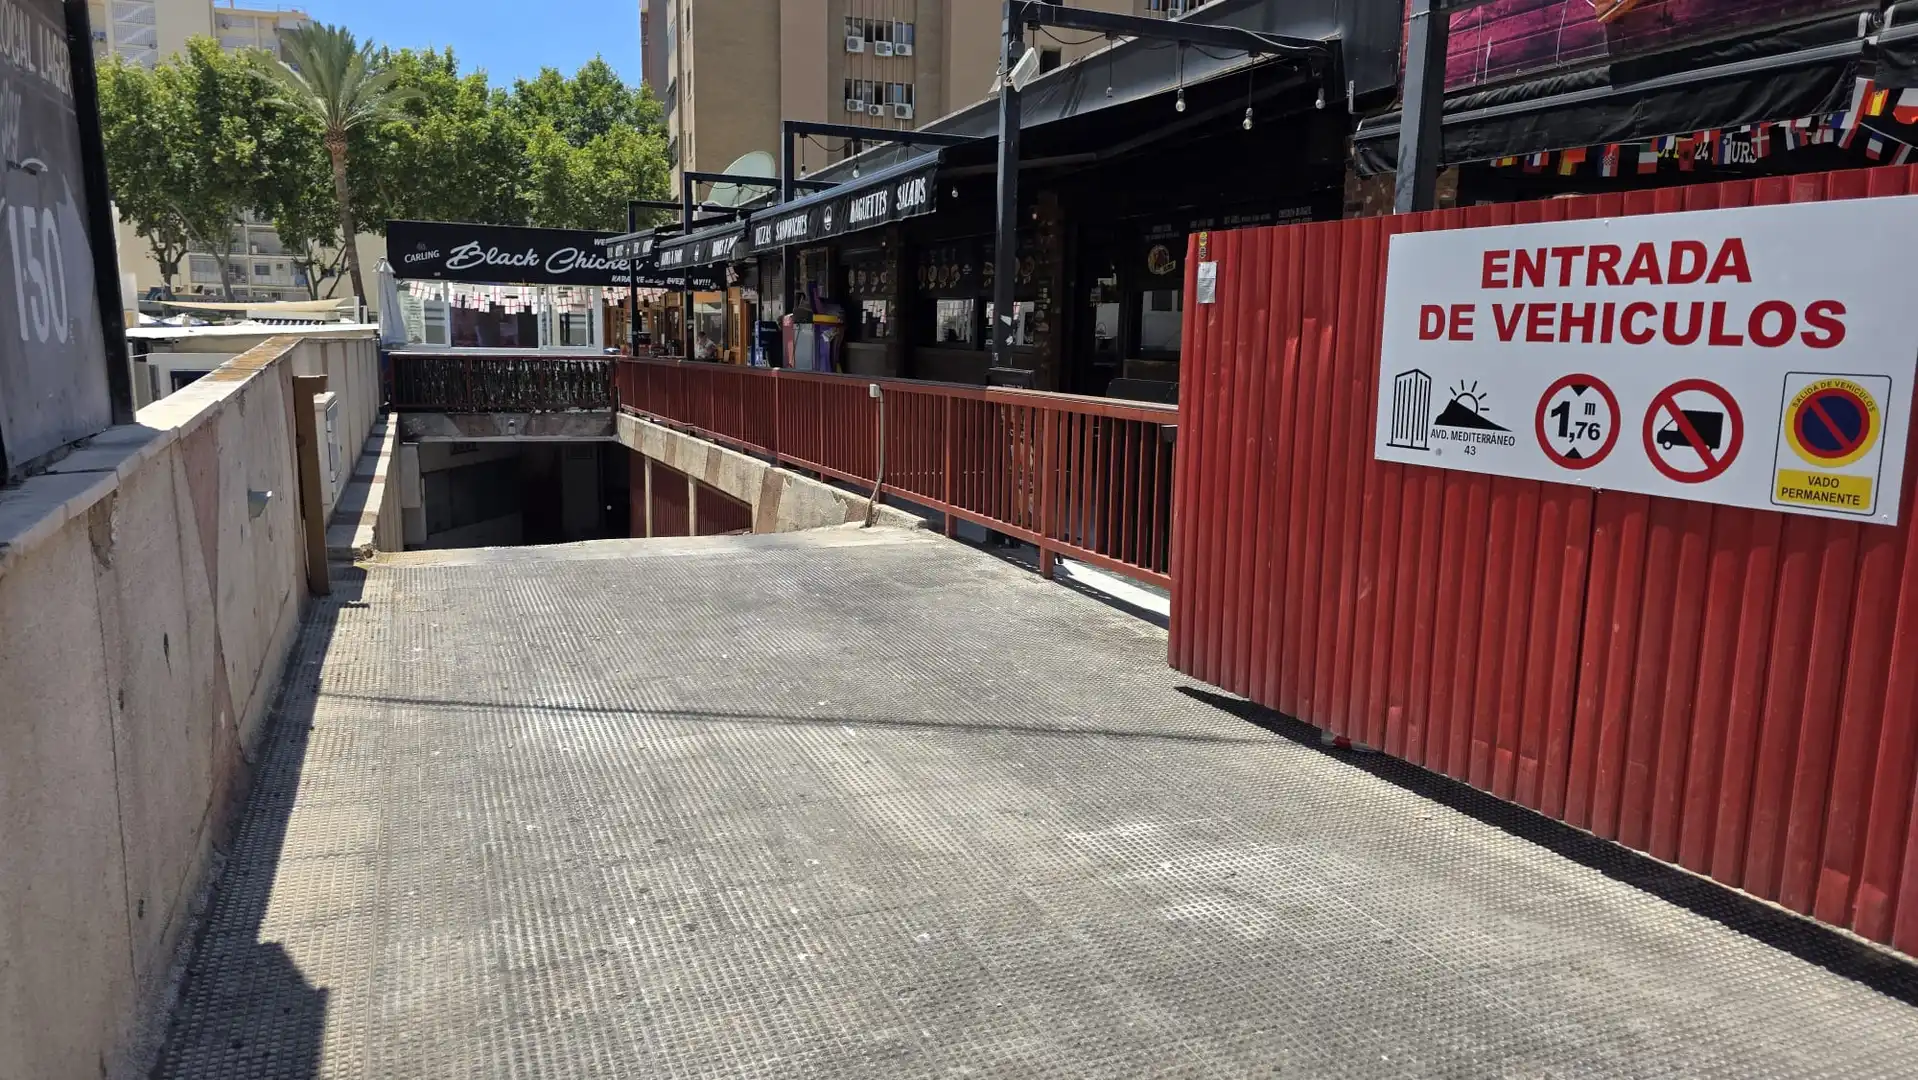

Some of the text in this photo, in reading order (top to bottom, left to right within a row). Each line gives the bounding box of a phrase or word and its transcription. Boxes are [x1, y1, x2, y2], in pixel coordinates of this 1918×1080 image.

[0, 0, 74, 99] OCAL LAGER
[775, 214, 808, 241] SANDWICHES
[850, 189, 888, 224] BAGUETTES
[896, 177, 926, 211] SALADS
[404, 250, 441, 263] CARLING
[446, 241, 540, 270] Black
[1481, 237, 1752, 289] ENTRADA
[8, 205, 69, 344] 150
[1418, 299, 1847, 349] DE VEHICULOS
[1792, 380, 1876, 413] SALIDA DE VEHICULOS
[1430, 429, 1516, 447] AVD. MEDITERRÁNEO
[1464, 445, 1477, 456] 43
[1781, 487, 1861, 506] PERMANENTE
[1808, 475, 1840, 489] VADO
